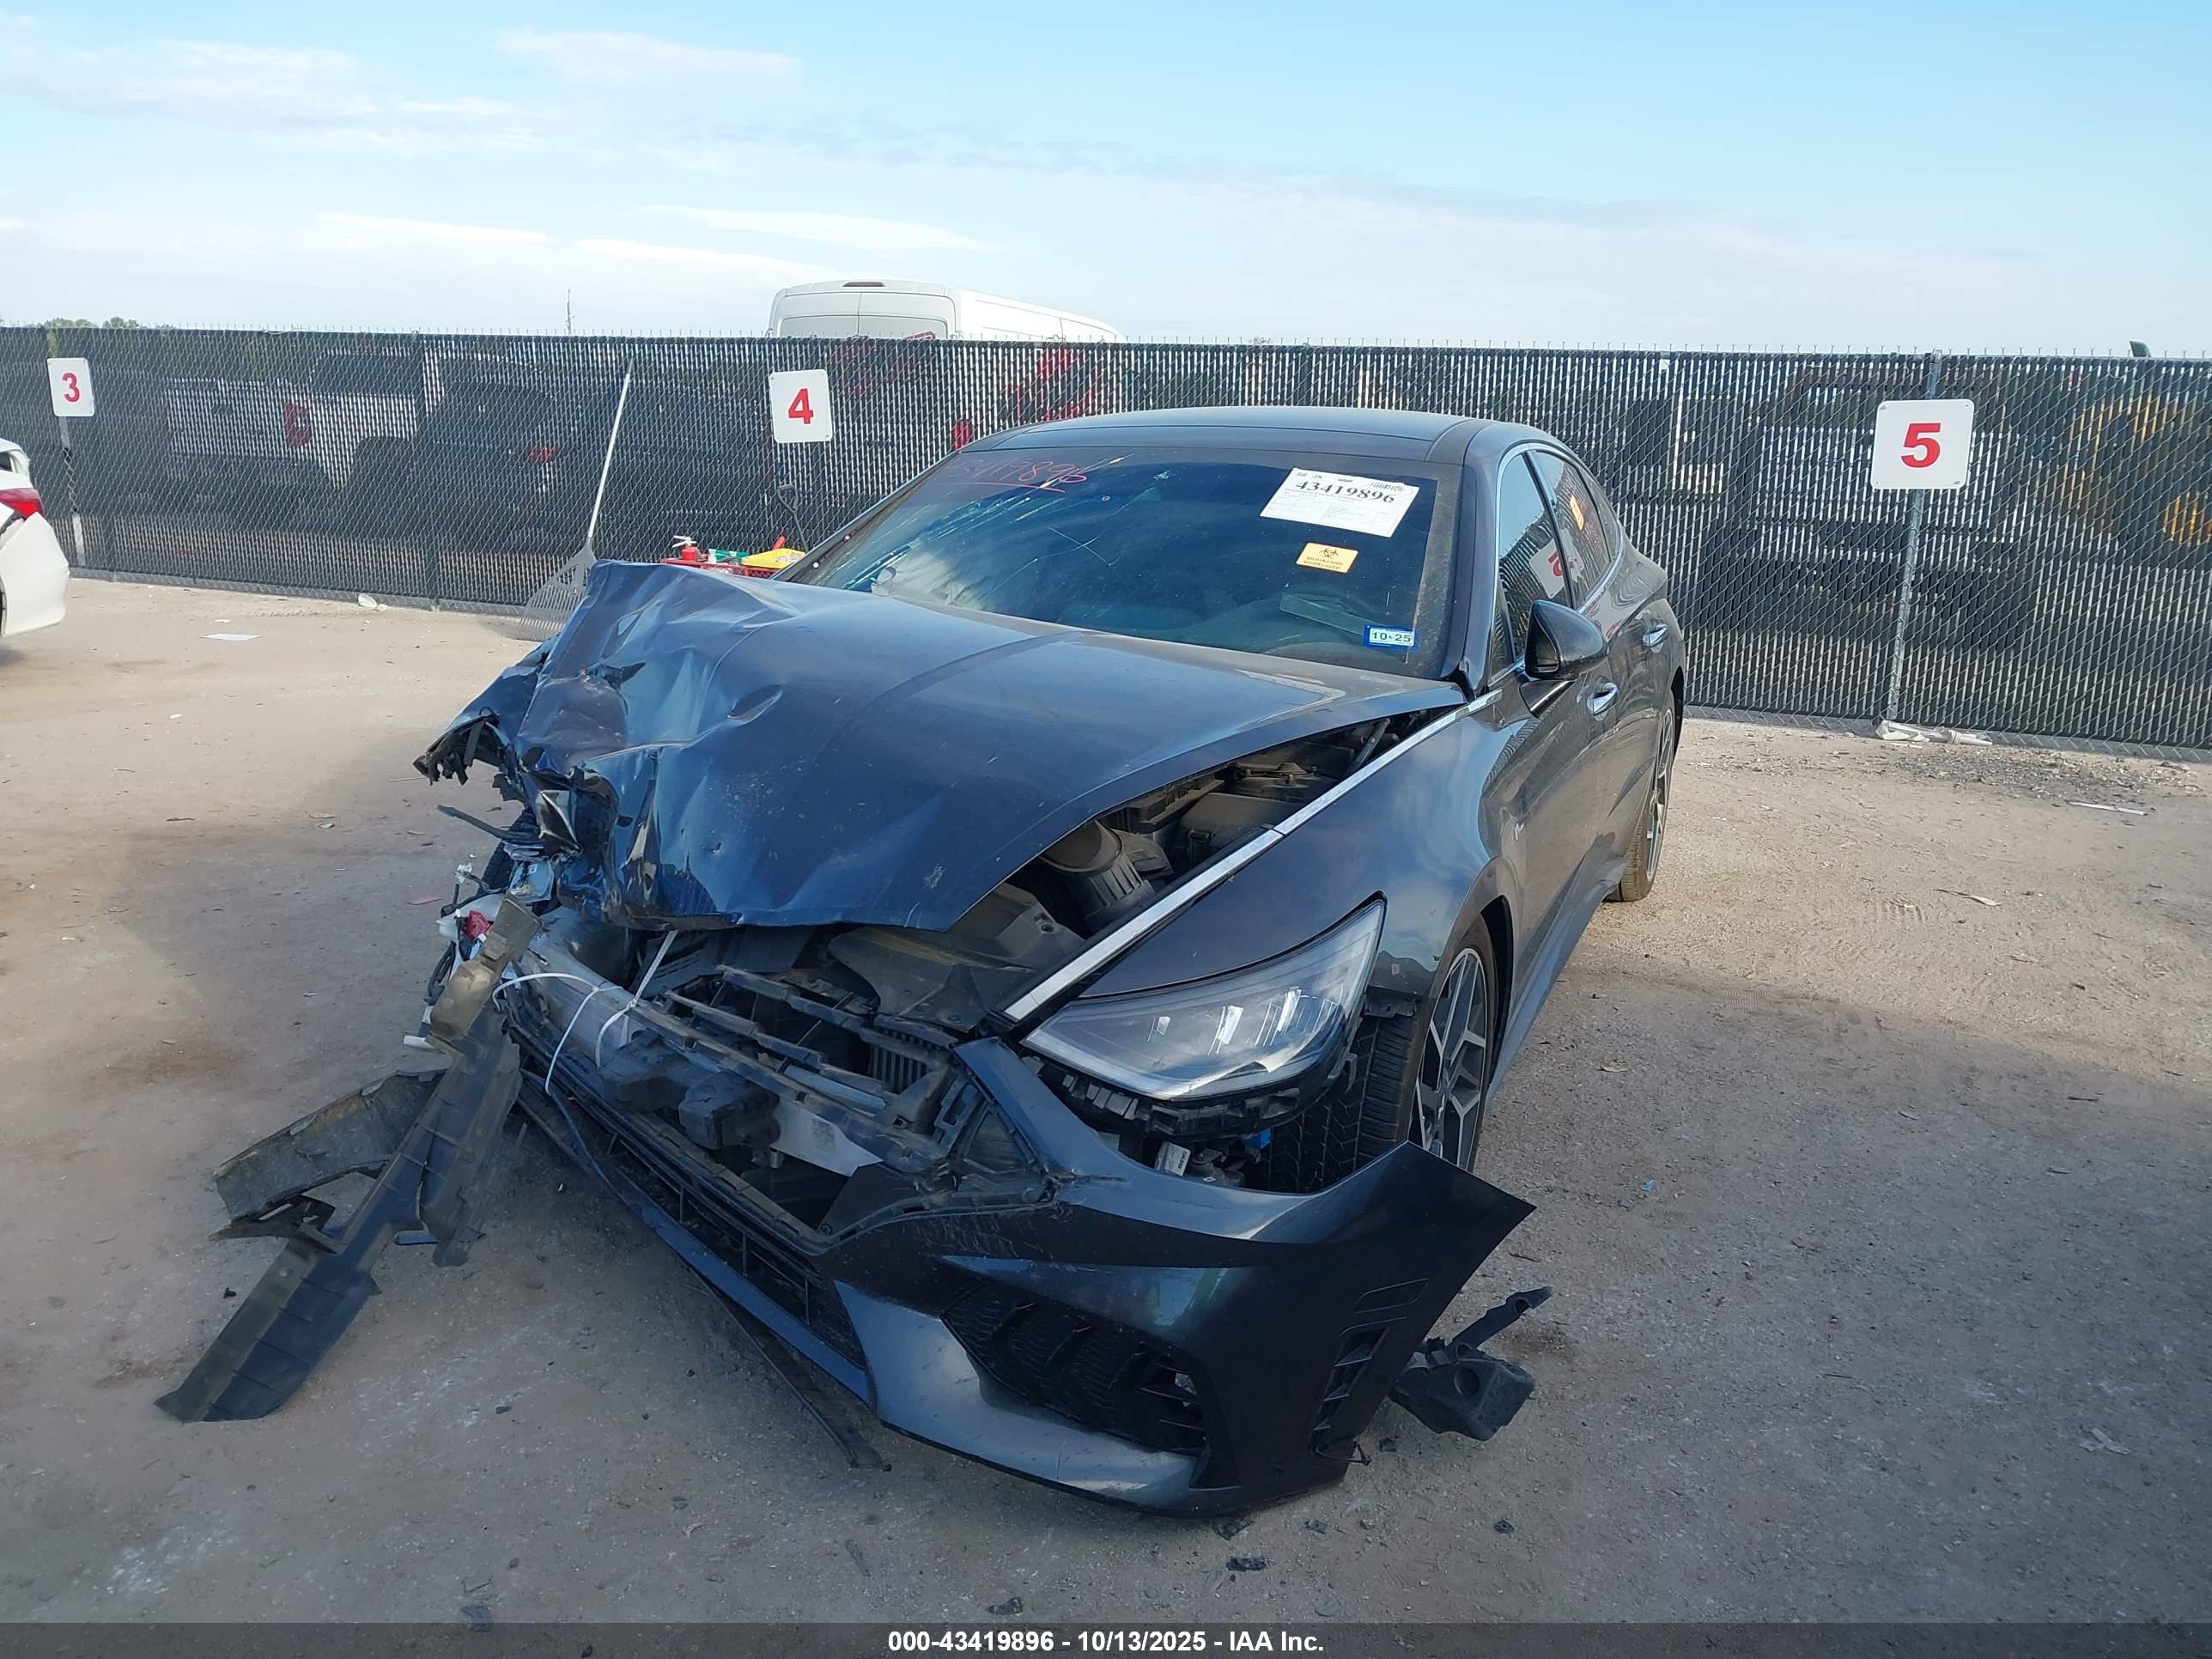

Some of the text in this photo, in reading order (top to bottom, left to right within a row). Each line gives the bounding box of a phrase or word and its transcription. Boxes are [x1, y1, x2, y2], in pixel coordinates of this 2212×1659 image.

[63, 372, 81, 403] 3
[787, 388, 814, 425] 4
[1900, 422, 1942, 469] 5
[1296, 480, 1395, 504] 43419896
